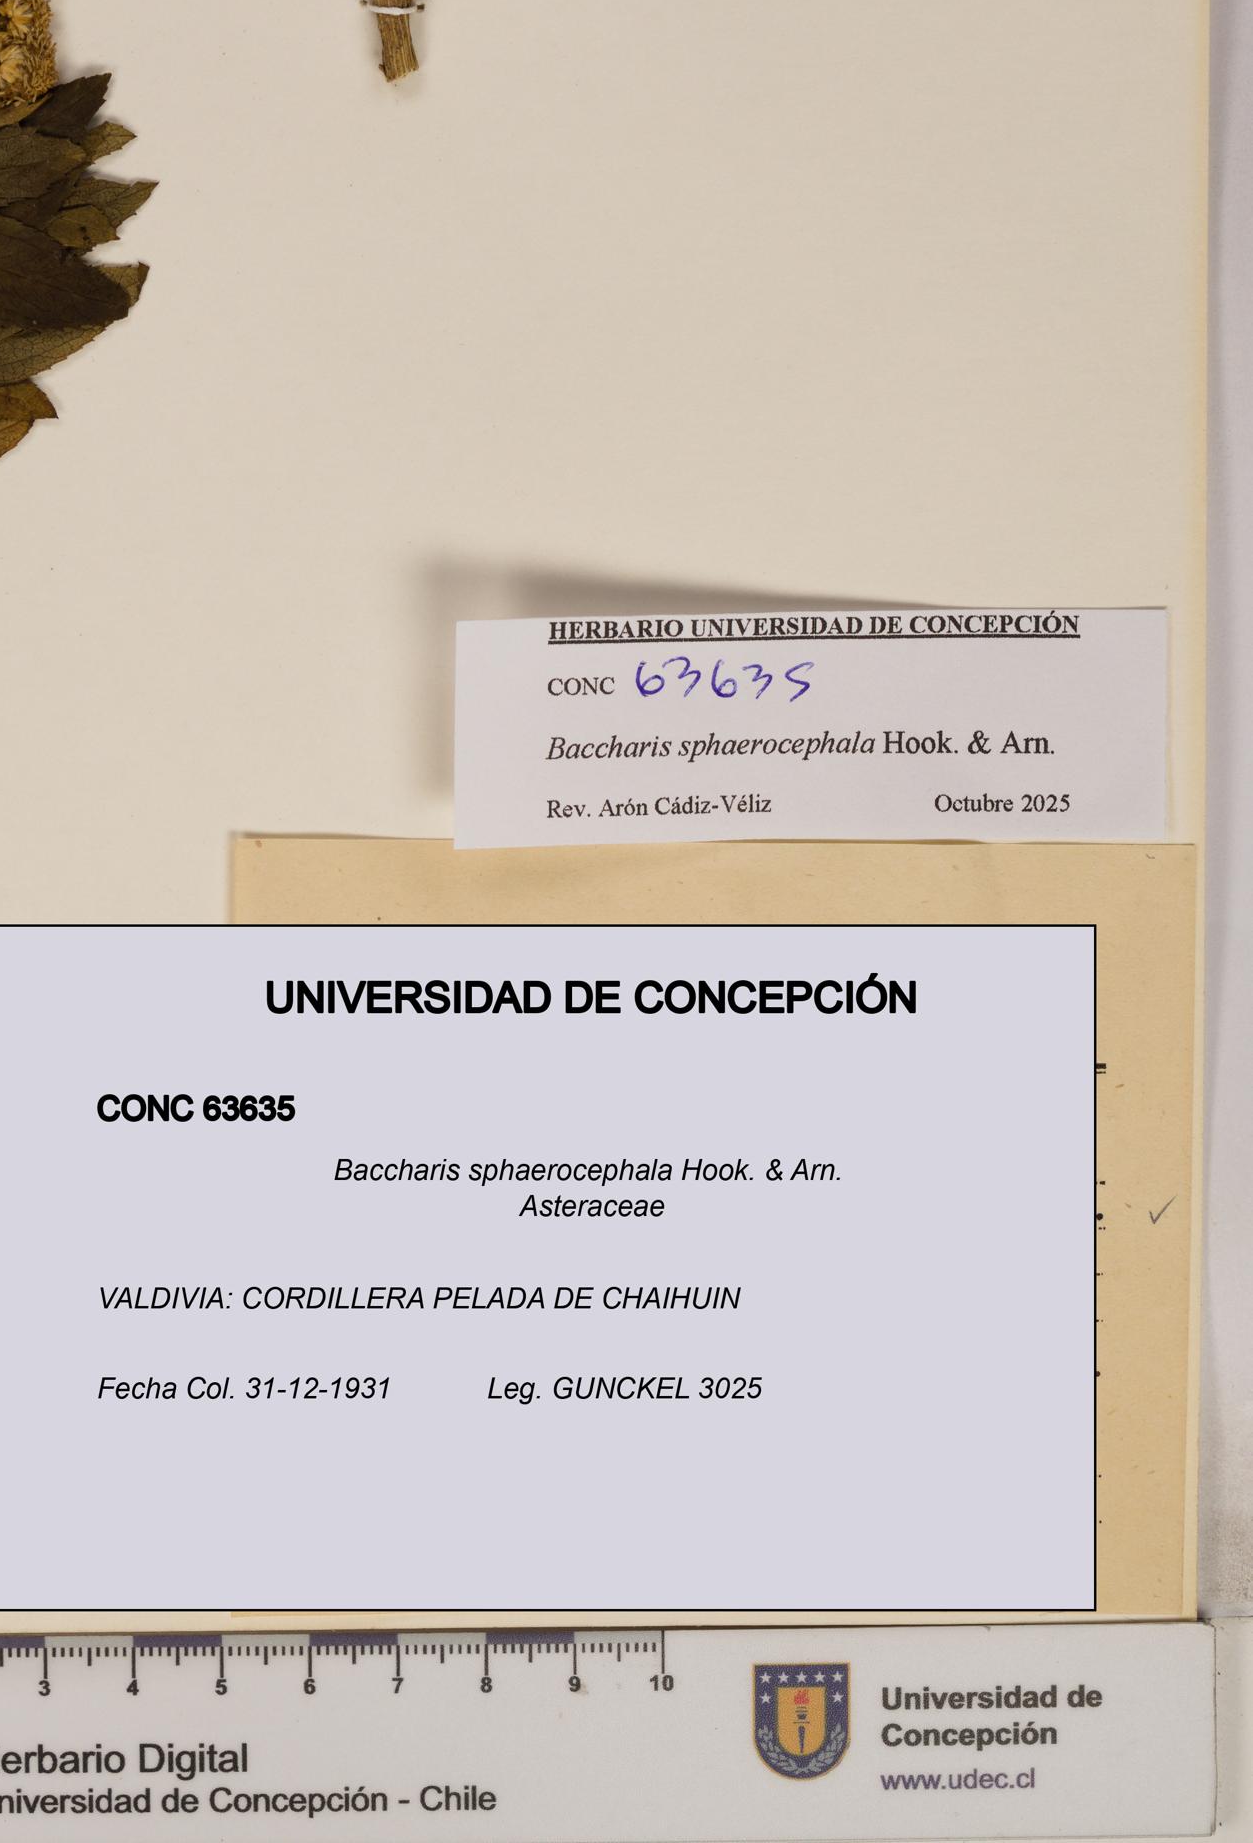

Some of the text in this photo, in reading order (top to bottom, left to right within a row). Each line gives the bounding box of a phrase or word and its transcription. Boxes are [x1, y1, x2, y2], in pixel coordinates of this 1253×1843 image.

[548, 609, 1081, 638] HERBARIO UNIVERSIDAD DE CONCEPCIÓN
[547, 676, 615, 697] CONC
[545, 729, 1055, 763] Baccharis sphaerocephala Hook. & Arn.
[546, 793, 772, 819] Rev. Arón Cádiz-Véliz
[934, 792, 1071, 813] Octubre 2025
[38, 1677, 51, 1697] 3
[126, 1677, 140, 1696] 4
[214, 1678, 228, 1696] 5
[303, 1677, 317, 1695] 6
[391, 1676, 404, 1694] 7
[479, 1676, 493, 1694] 8
[567, 1675, 582, 1693] 9
[649, 1674, 675, 1692] 10
[881, 1684, 1103, 1711] Universidad de
[880, 1721, 1058, 1752] Concepción
[138, 1742, 248, 1782] Digital
[879, 1767, 1036, 1791] www.udec.cl
[161, 1787, 200, 1814] de
[208, 1785, 388, 1819] Concepción
[419, 1784, 497, 1812] Chile
